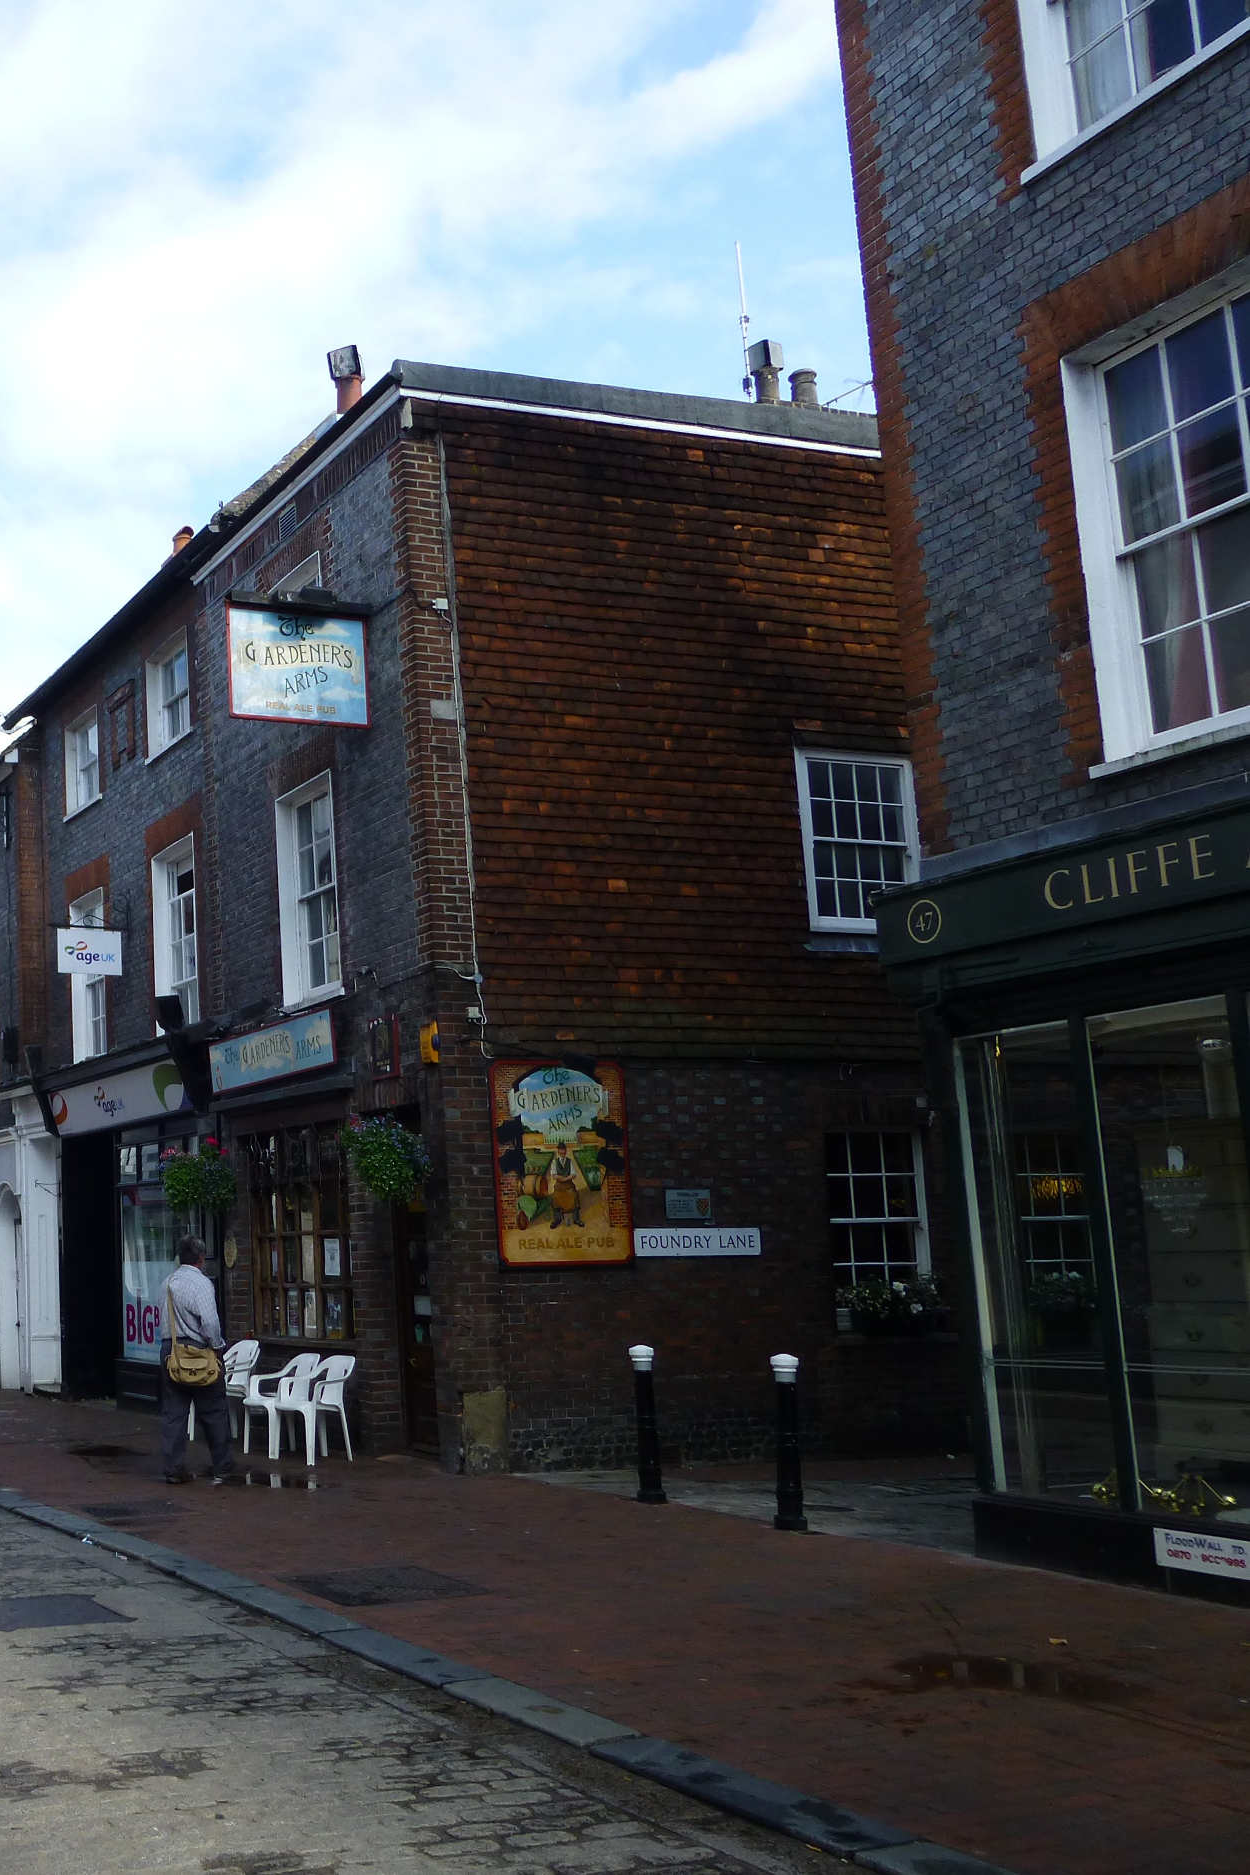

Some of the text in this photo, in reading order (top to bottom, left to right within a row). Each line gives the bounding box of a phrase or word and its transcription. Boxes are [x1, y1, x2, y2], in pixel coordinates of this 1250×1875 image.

[278, 616, 314, 641] The
[245, 641, 353, 669] GARDENER'S
[285, 666, 329, 698] ARMS
[266, 701, 336, 714] REAL ALE PUB
[1044, 834, 1215, 910] CLIFFE
[915, 911, 934, 932] 47
[296, 1035, 322, 1060] ARMS
[542, 1066, 570, 1086] The
[548, 1106, 583, 1132] ARMS
[518, 1236, 615, 1250] REAL ALE PUB
[640, 1234, 755, 1249] FOUNDRY LANE
[126, 1297, 154, 1344] BIG
